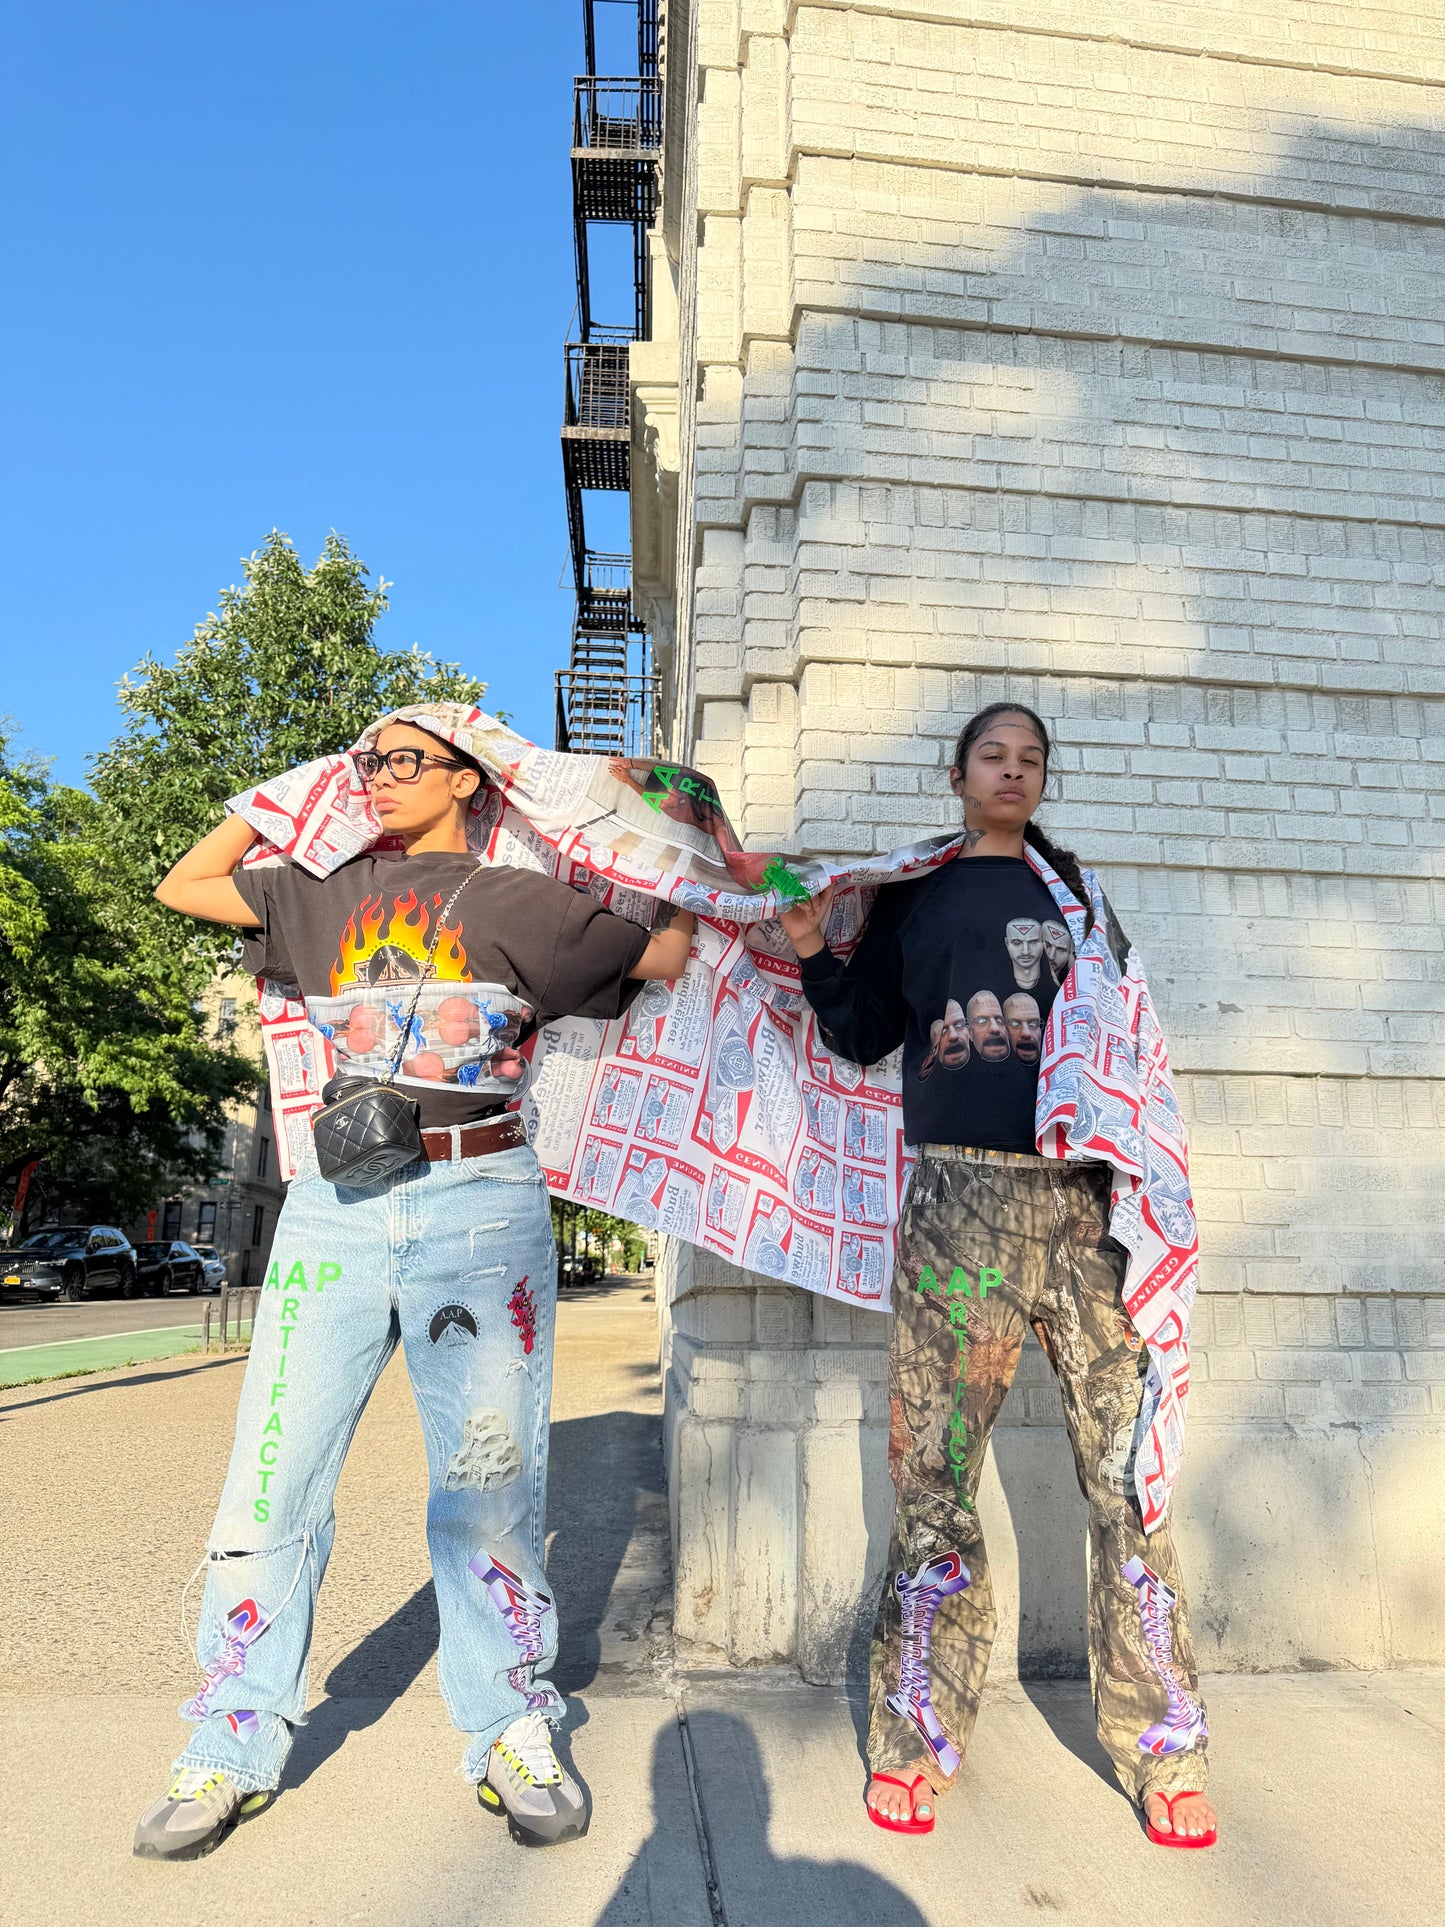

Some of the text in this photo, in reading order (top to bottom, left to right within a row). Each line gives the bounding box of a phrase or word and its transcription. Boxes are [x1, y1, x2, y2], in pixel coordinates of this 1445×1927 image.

[265, 1260, 342, 1293] AAP
[916, 1264, 1003, 1298] AAP
[1131, 1257, 1179, 1312] GENUINE
